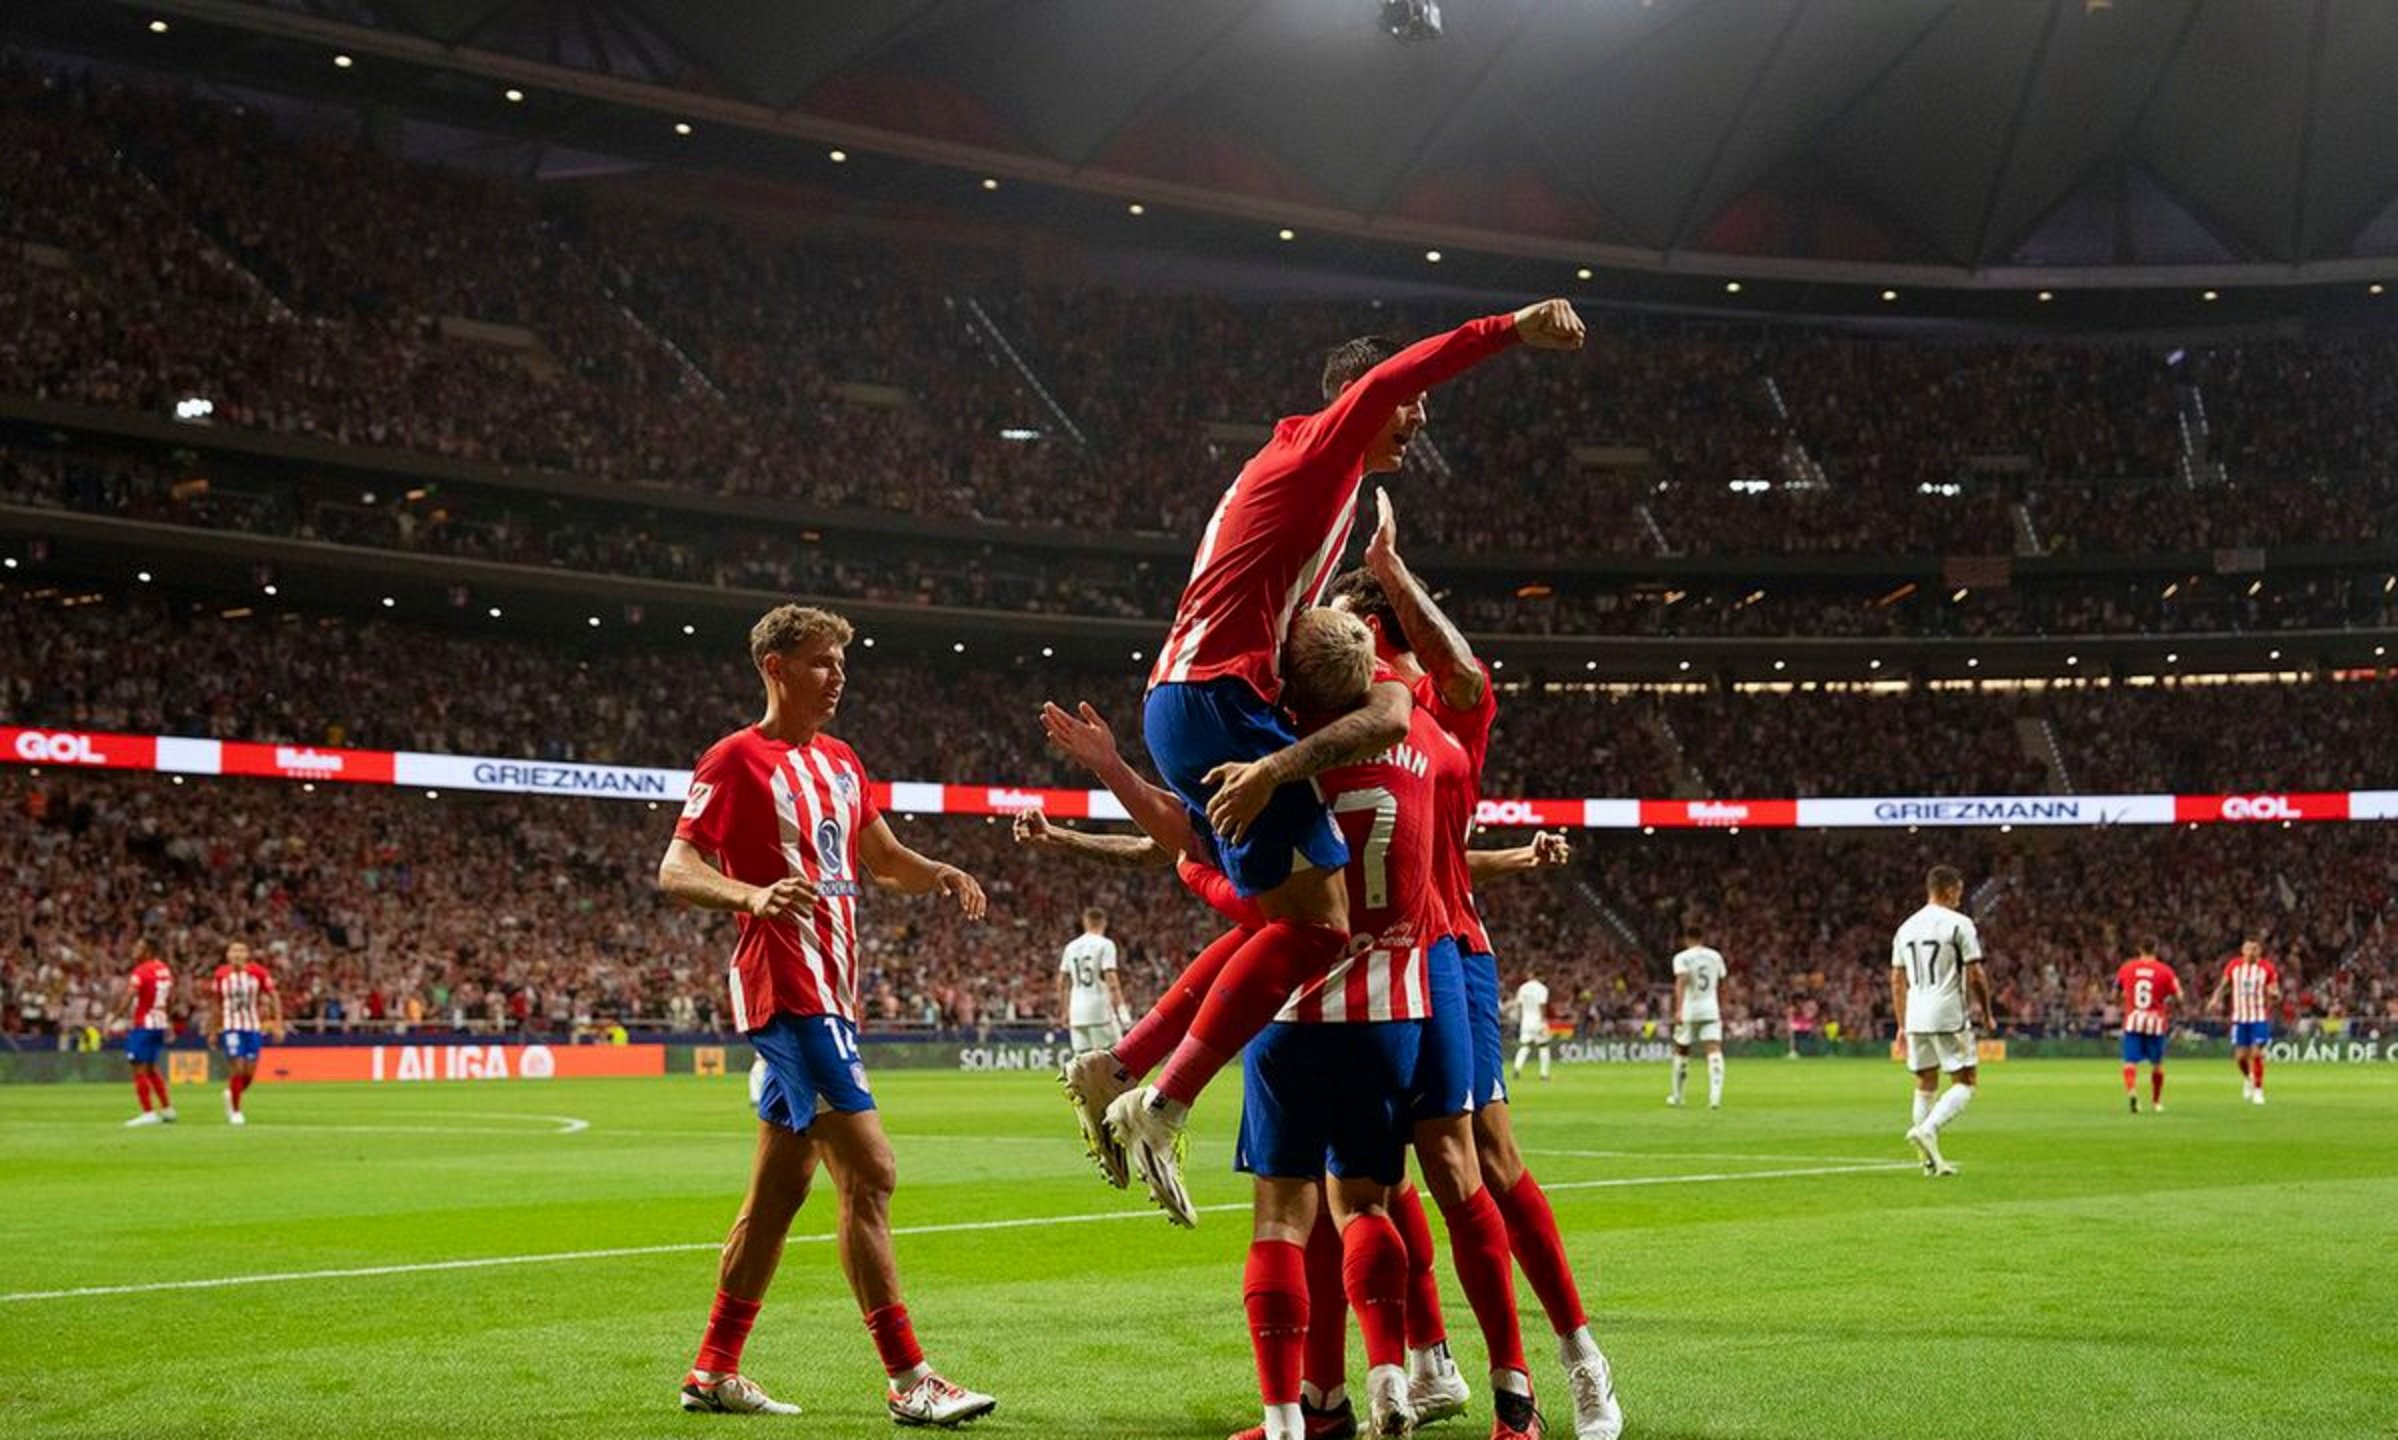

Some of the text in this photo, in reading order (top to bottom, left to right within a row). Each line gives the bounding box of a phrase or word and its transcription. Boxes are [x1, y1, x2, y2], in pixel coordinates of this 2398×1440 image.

[15, 731, 107, 763] GOL
[473, 762, 666, 793] GRIEZMANN
[1475, 800, 1544, 824] GOL
[1874, 801, 2080, 820] GRIEZMANN
[2221, 796, 2302, 820] GOL
[1334, 787, 1397, 909] 7
[1073, 955, 1093, 988] 15
[1907, 940, 1941, 985] 17
[1697, 965, 1710, 991] 5
[2134, 979, 2153, 1009] 6
[1029, 1048, 1054, 1070] DE
[1608, 1043, 1627, 1061] DE
[2348, 1042, 2378, 1062] DE
